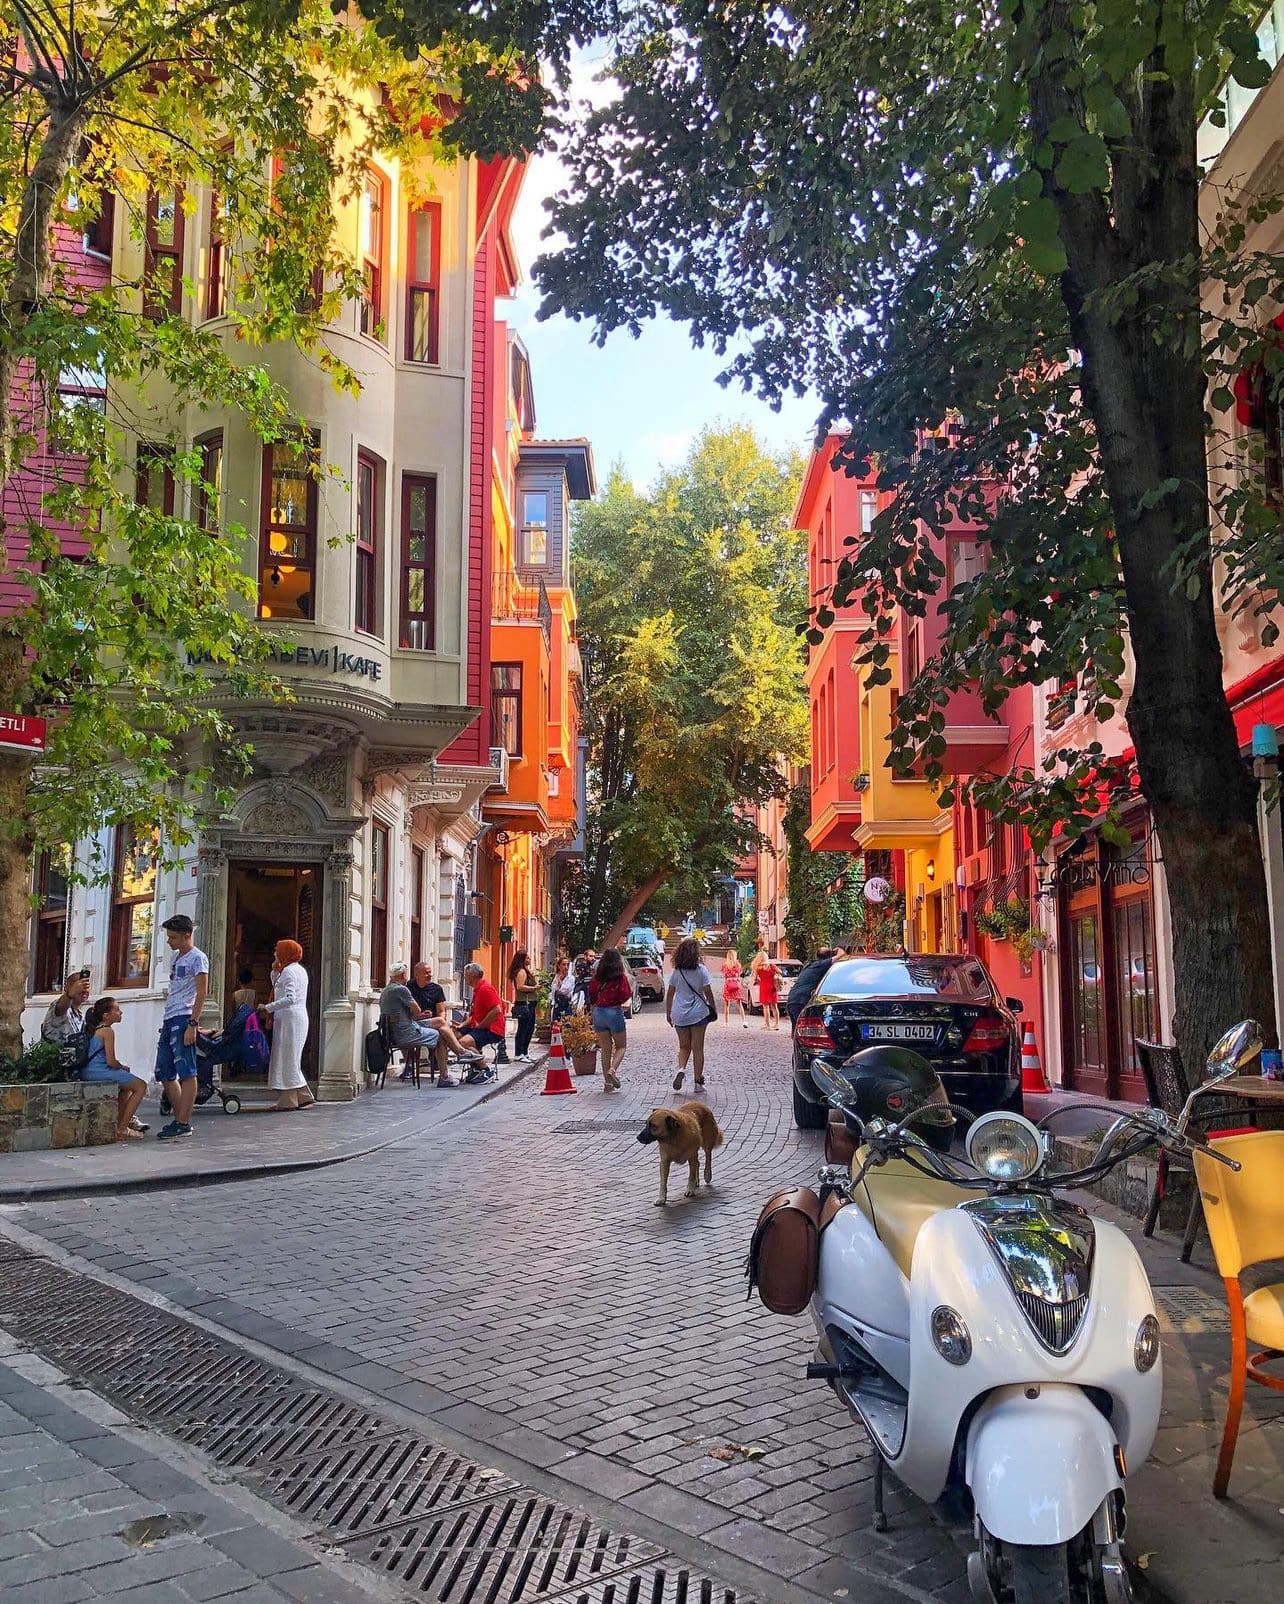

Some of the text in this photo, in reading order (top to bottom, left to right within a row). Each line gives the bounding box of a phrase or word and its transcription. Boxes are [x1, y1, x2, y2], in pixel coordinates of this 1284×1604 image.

[342, 652, 382, 680] KAFE
[869, 1026, 933, 1038] 34 SL 0402
